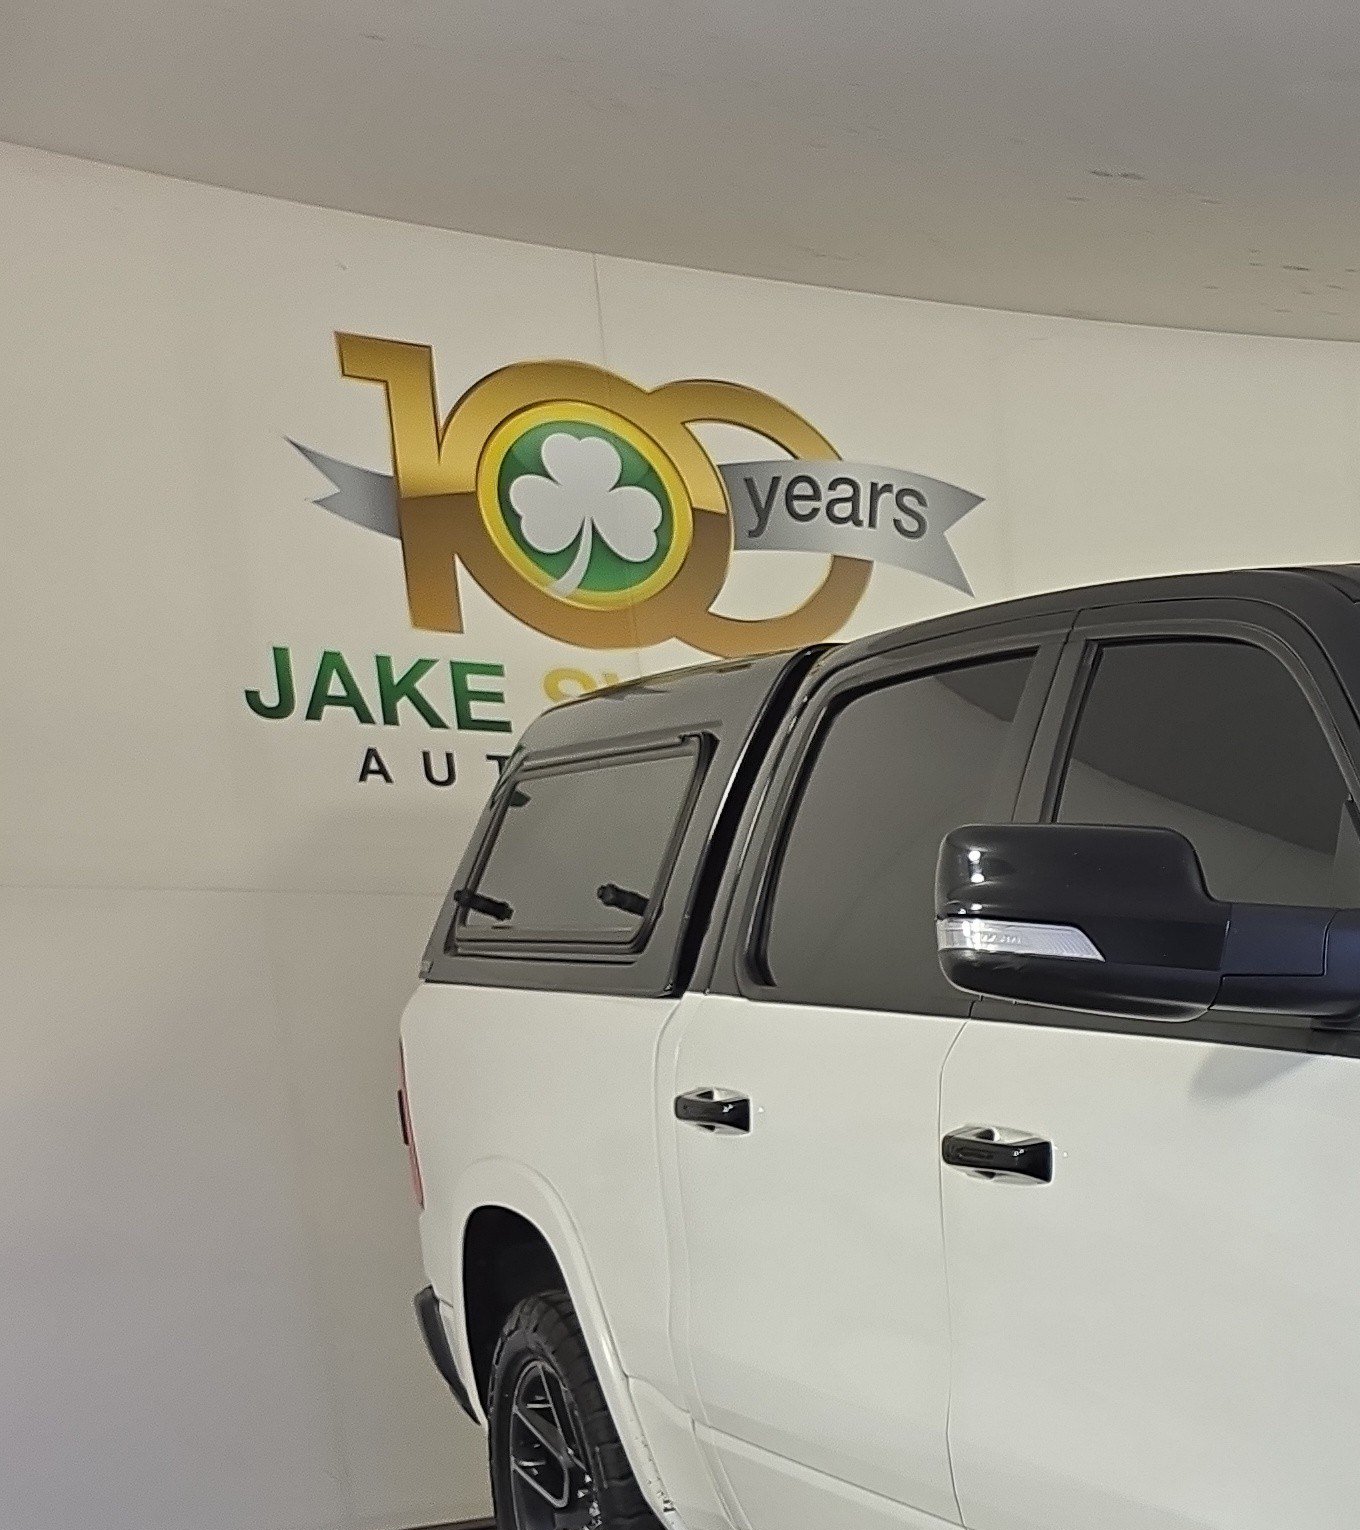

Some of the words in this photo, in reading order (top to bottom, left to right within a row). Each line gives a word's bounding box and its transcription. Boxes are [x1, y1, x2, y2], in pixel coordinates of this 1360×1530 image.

[335, 331, 873, 658] 100
[744, 464, 929, 539] years
[244, 646, 513, 733] JAKE
